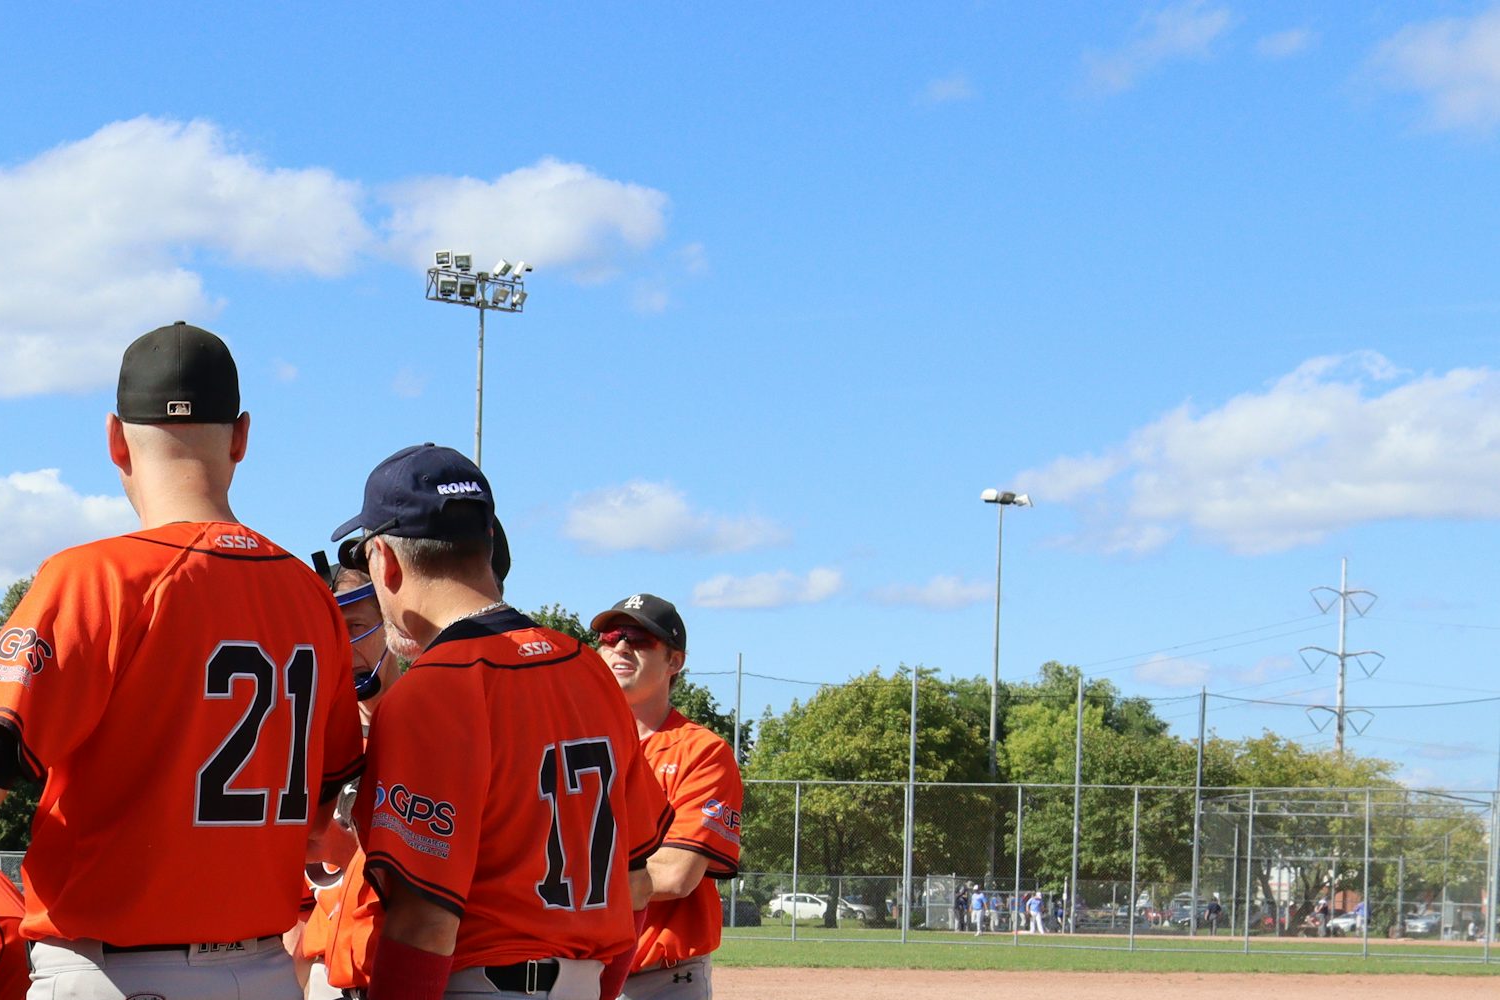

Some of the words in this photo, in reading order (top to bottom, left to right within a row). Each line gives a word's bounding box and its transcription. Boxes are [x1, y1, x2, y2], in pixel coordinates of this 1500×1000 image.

[436, 481, 482, 495] RONA
[220, 534, 260, 550] SSP
[624, 594, 644, 610] LA
[520, 640, 553, 657] SSP
[193, 640, 318, 827] 21
[388, 783, 456, 837] GPS
[722, 805, 741, 829] GP
[534, 736, 617, 912] 17
